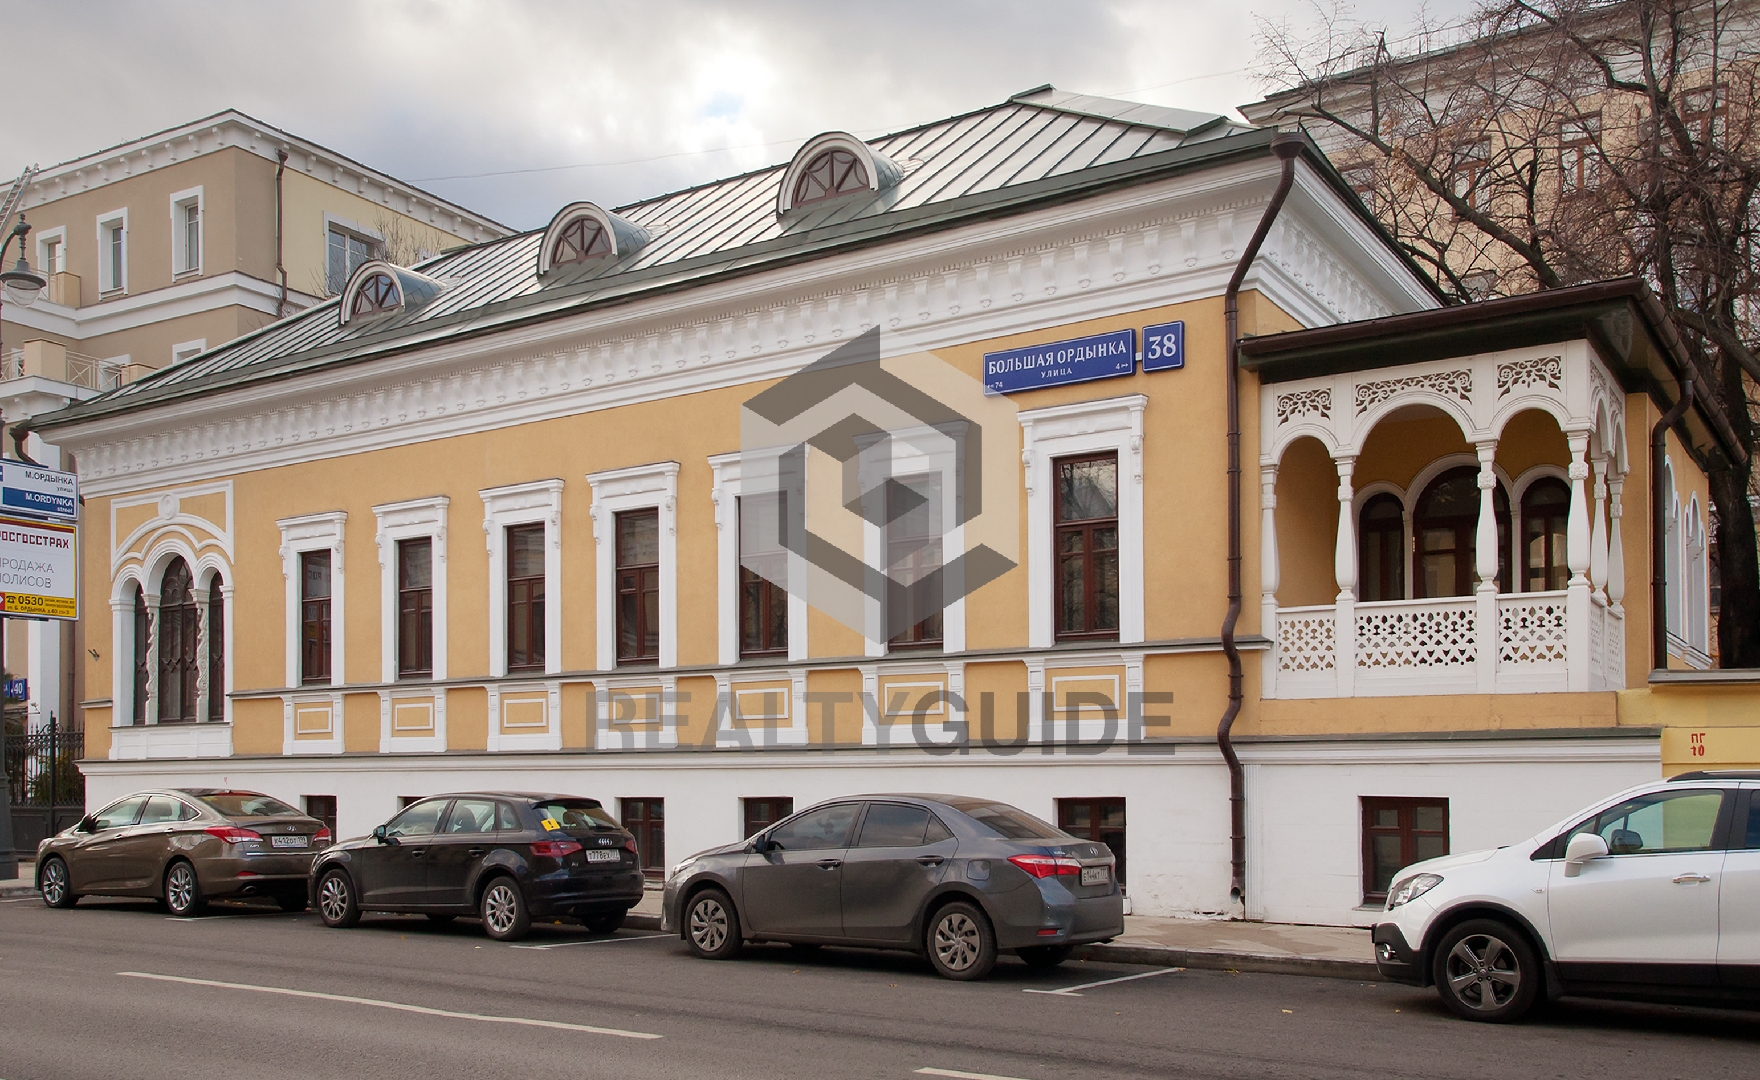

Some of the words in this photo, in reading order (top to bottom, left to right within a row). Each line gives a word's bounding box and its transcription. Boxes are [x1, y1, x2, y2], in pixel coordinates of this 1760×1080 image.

[1147, 333, 1177, 360] 38
[988, 351, 1054, 376] БОЛЬШАЯ
[1057, 340, 1127, 366] ОРДЫНКА
[1040, 369, 1073, 379] УЛИЦА
[995, 381, 1003, 389] 74
[57, 506, 73, 514] street
[0, 531, 69, 549] ОСГОССТРАХ
[0, 557, 54, 573] РОДАЖА
[0, 571, 52, 588] ОЛИСОВ
[18, 595, 44, 606] 0530
[14, 682, 23, 695] 40
[1691, 732, 1706, 744] ПГ
[1690, 744, 1705, 757] 10
